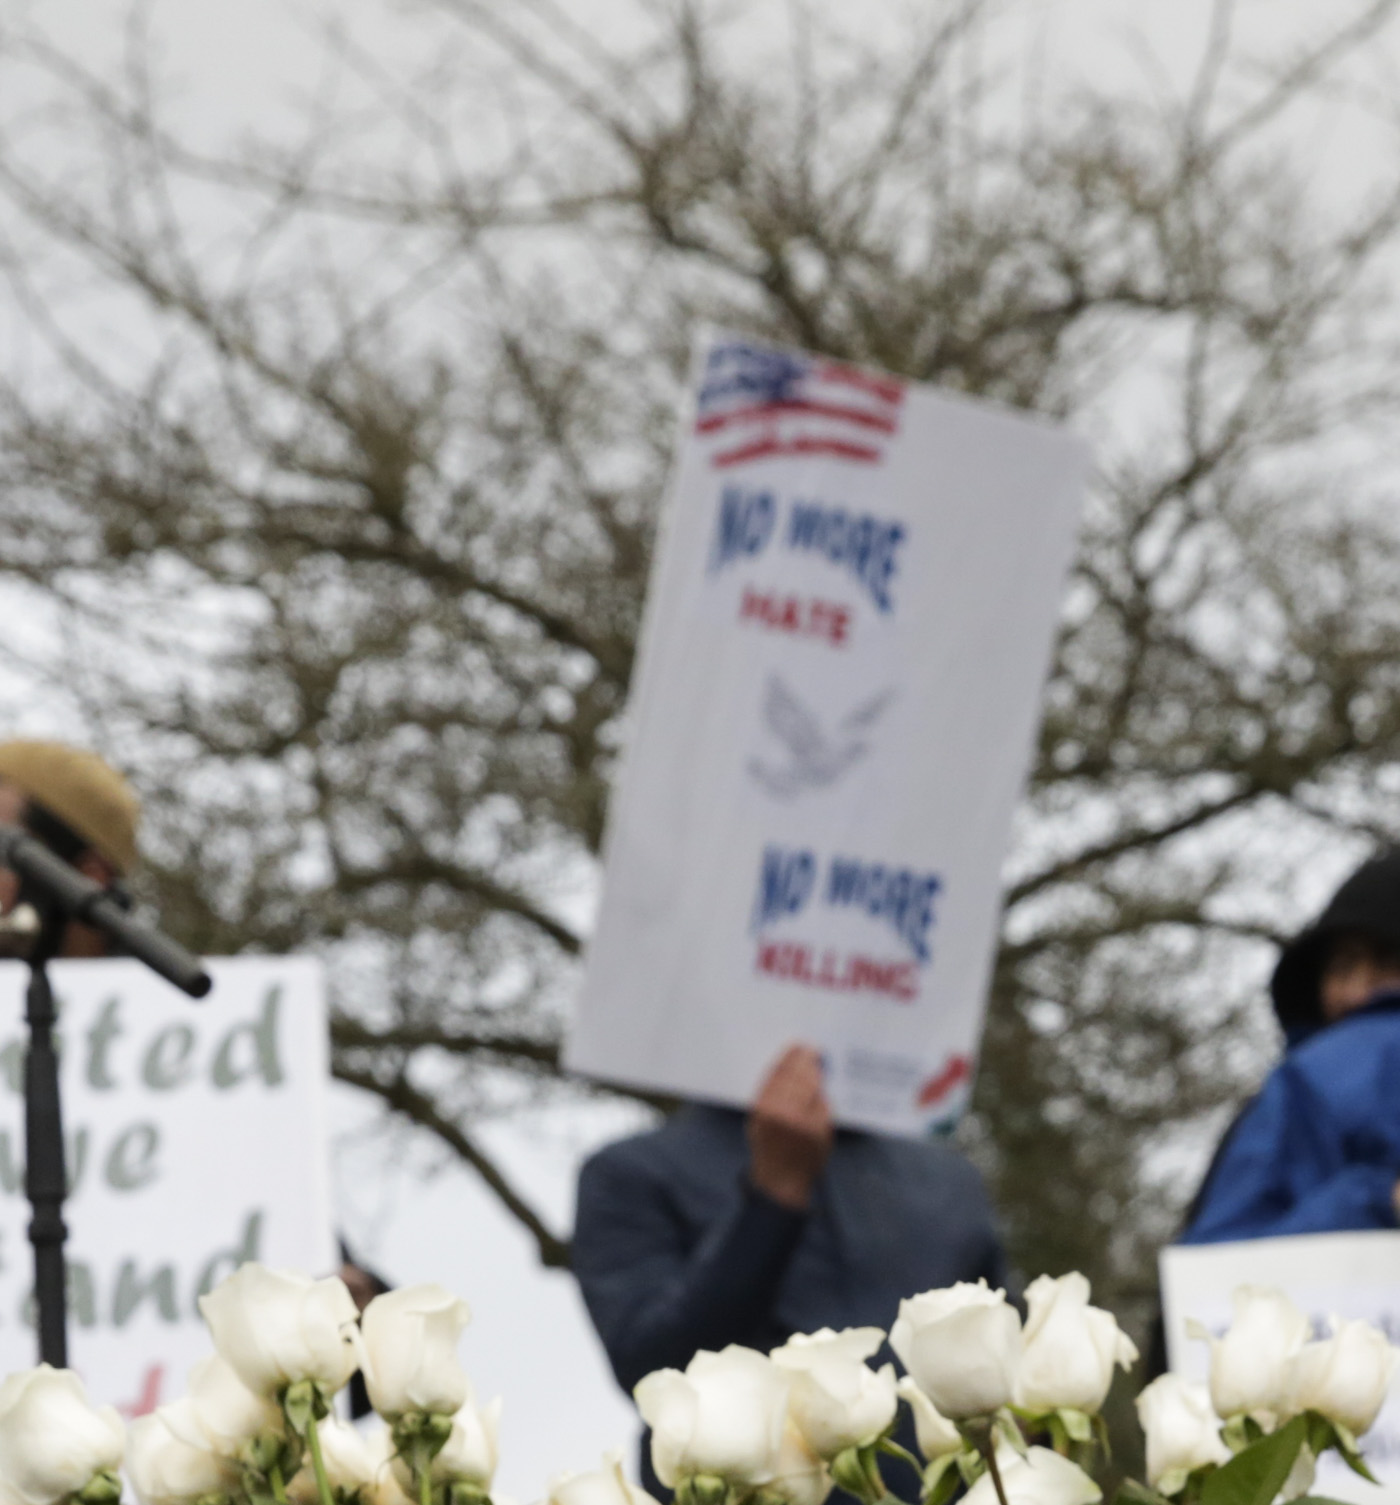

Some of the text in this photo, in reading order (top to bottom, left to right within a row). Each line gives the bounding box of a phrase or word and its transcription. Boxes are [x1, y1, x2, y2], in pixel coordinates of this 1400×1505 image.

[706, 483, 907, 616] NO MORE
[739, 588, 851, 647] HATE
[750, 844, 942, 967] NO MORE
[755, 940, 919, 1002] KILLING
